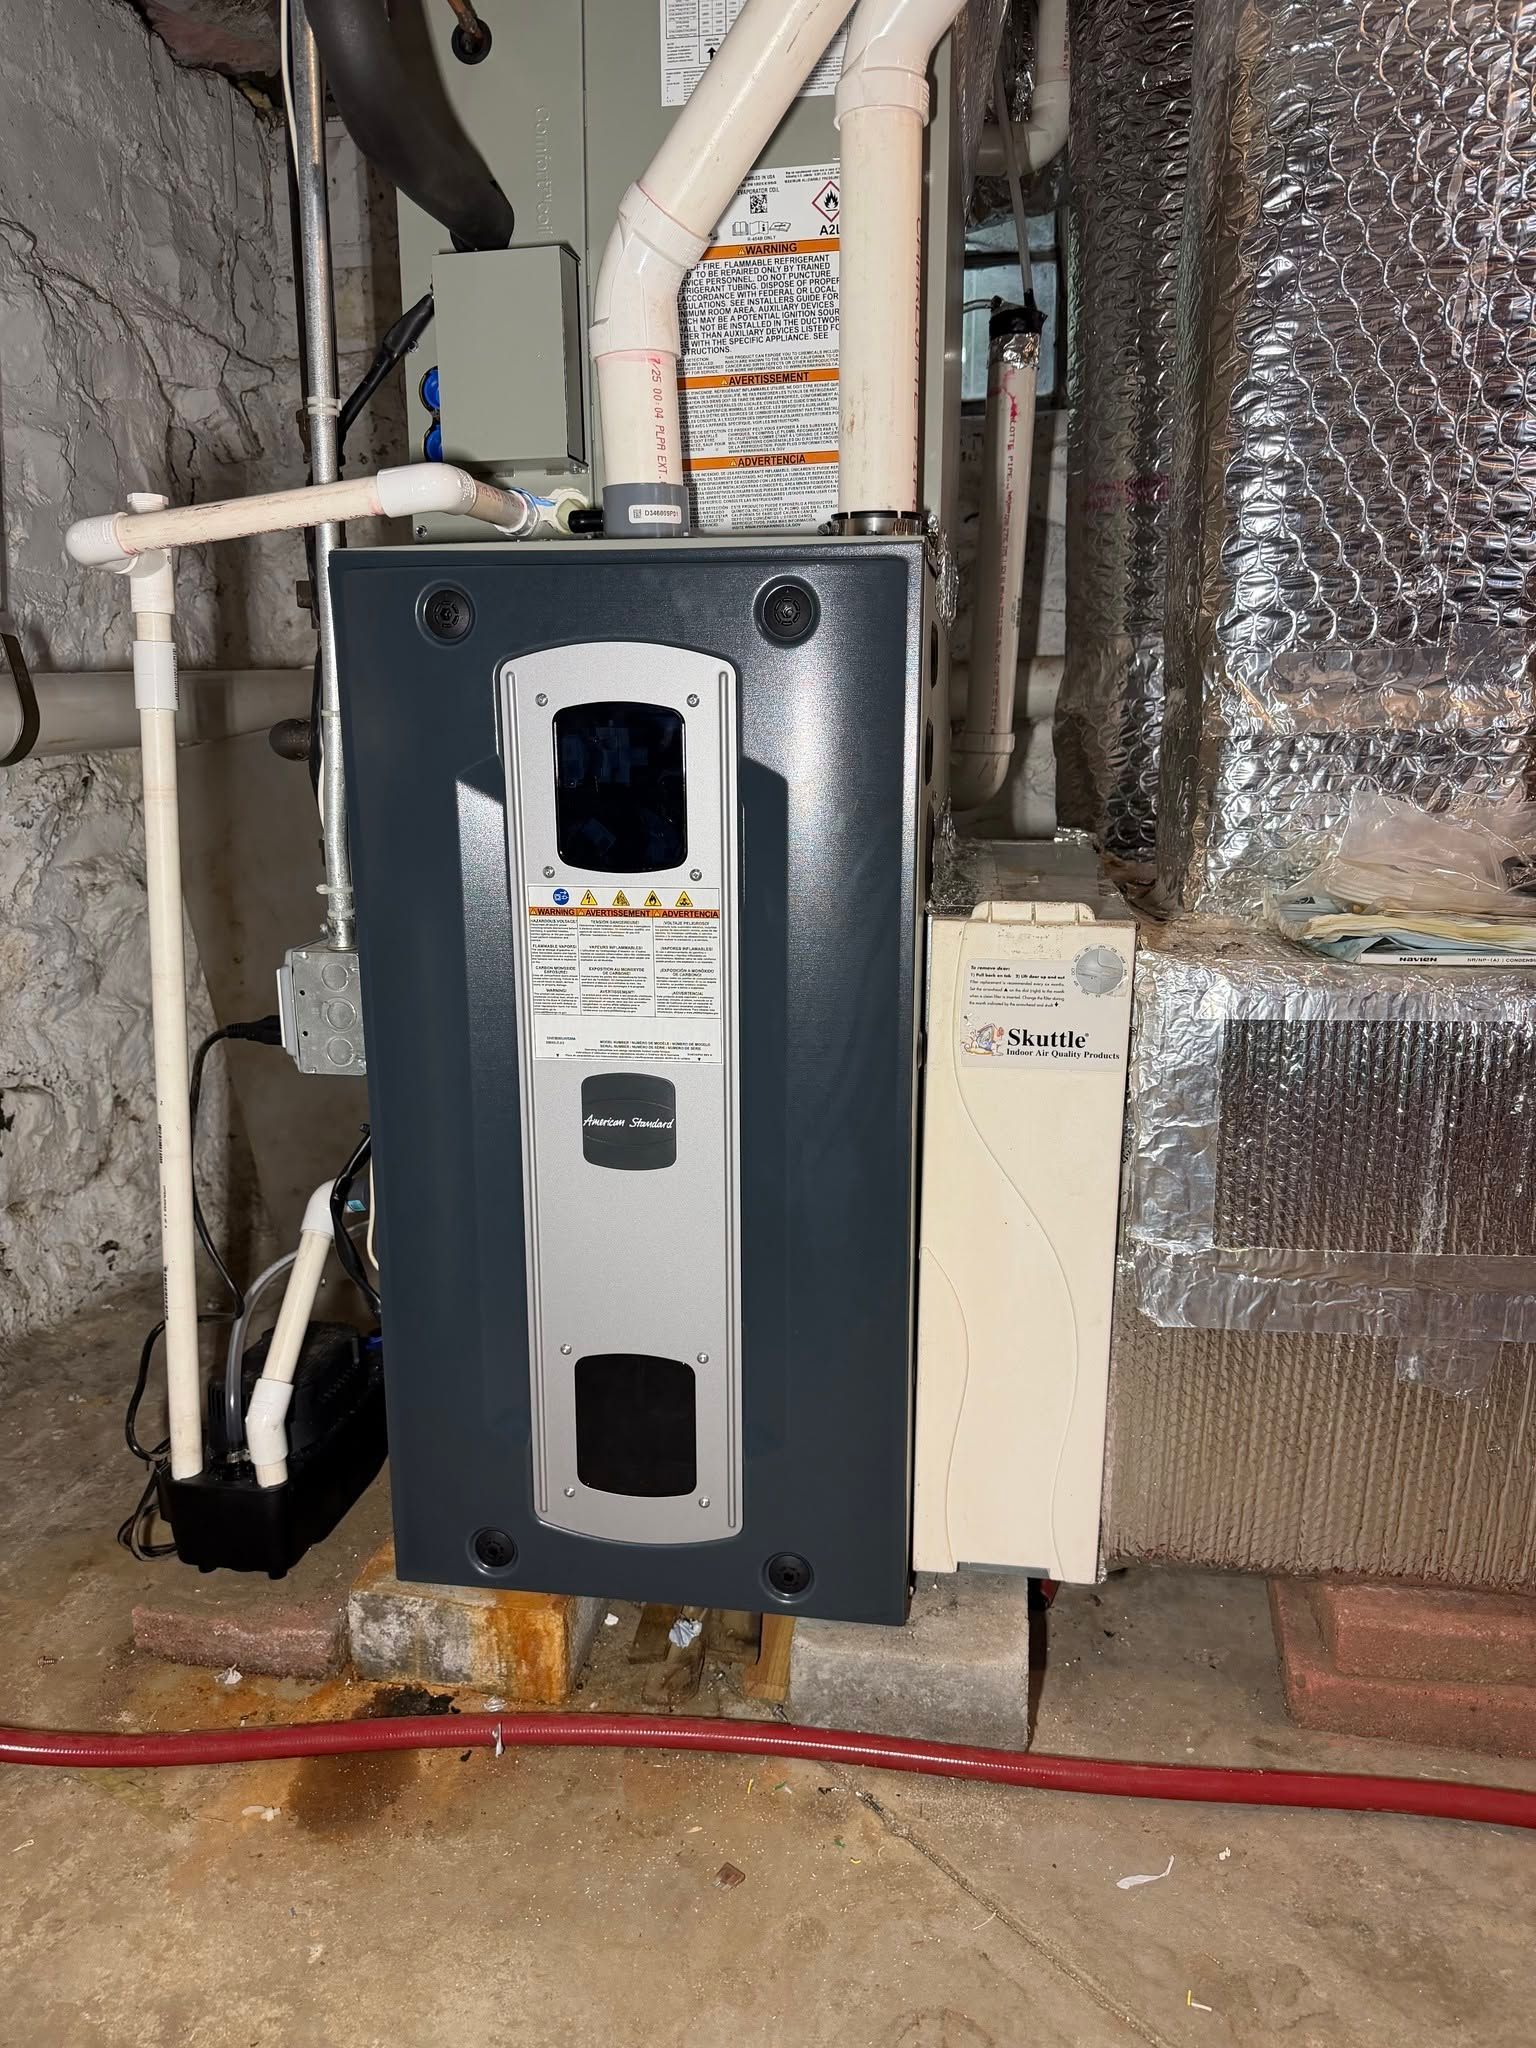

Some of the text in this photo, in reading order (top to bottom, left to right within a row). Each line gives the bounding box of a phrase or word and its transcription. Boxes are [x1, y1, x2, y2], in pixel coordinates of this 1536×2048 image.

[745, 243, 797, 255] WARNING
[725, 258, 772, 268] FLAMMABLE
[775, 254, 830, 265] REFRIGERANT
[721, 267, 759, 276] REPAIRED
[761, 266, 781, 274] ONLY
[784, 264, 794, 272] BY
[796, 262, 830, 271] TRAINED
[706, 276, 754, 285] PERSONNEL.
[789, 270, 831, 280] PUNCTURE
[728, 282, 758, 291] TUBING.
[761, 280, 794, 289] DISPOSE
[681, 292, 736, 302] ACCORDANCE
[759, 288, 794, 297] FEDERAL
[810, 285, 836, 294] LOCAL
[748, 296, 794, 305] INSTALLERS
[796, 294, 820, 302] GUIDE
[708, 308, 730, 316] ROOM
[758, 303, 798, 312] AUXILIARY
[800, 301, 834, 309] DEVICES
[738, 312, 780, 322] POTENTIAL
[782, 310, 816, 318] IGNITION
[818, 308, 840, 316] SOUR
[724, 329, 764, 338] AUXILIARY
[766, 326, 800, 335] DEVICES
[802, 324, 828, 332] LISTED
[730, 320, 772, 329] INSTALLED
[729, 336, 764, 345] SPECIFIC
[729, 372, 809, 386] AVERTISSEMENT
[738, 454, 806, 467] ADVERTENCIA
[586, 909, 650, 918] AVERTISSEMENT
[662, 910, 719, 918] ADVERTENCIA
[1008, 1028, 1086, 1048] Skuttle
[1051, 1050, 1081, 1060] Quality
[1084, 1052, 1120, 1060] Products
[582, 1114, 674, 1128] American Standard
